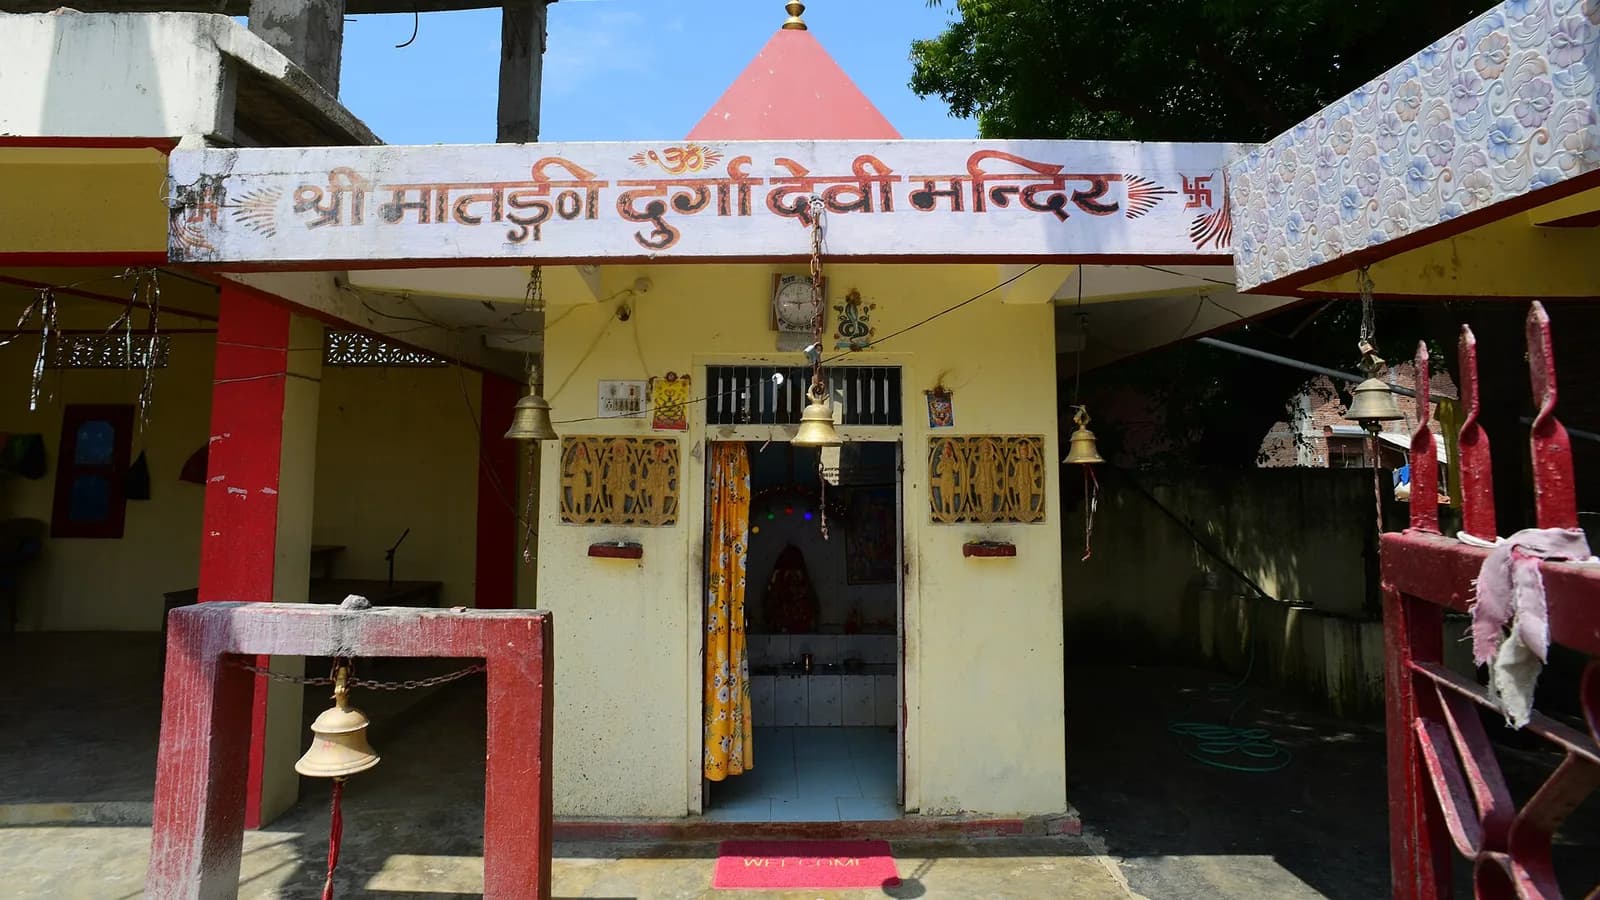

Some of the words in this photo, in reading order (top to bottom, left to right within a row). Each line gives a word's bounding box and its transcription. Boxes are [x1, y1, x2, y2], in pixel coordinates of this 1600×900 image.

[293, 166, 374, 230] श्री
[616, 155, 764, 250] दुर्गा
[766, 154, 901, 228] देवी
[908, 149, 1122, 222] मन्दिर
